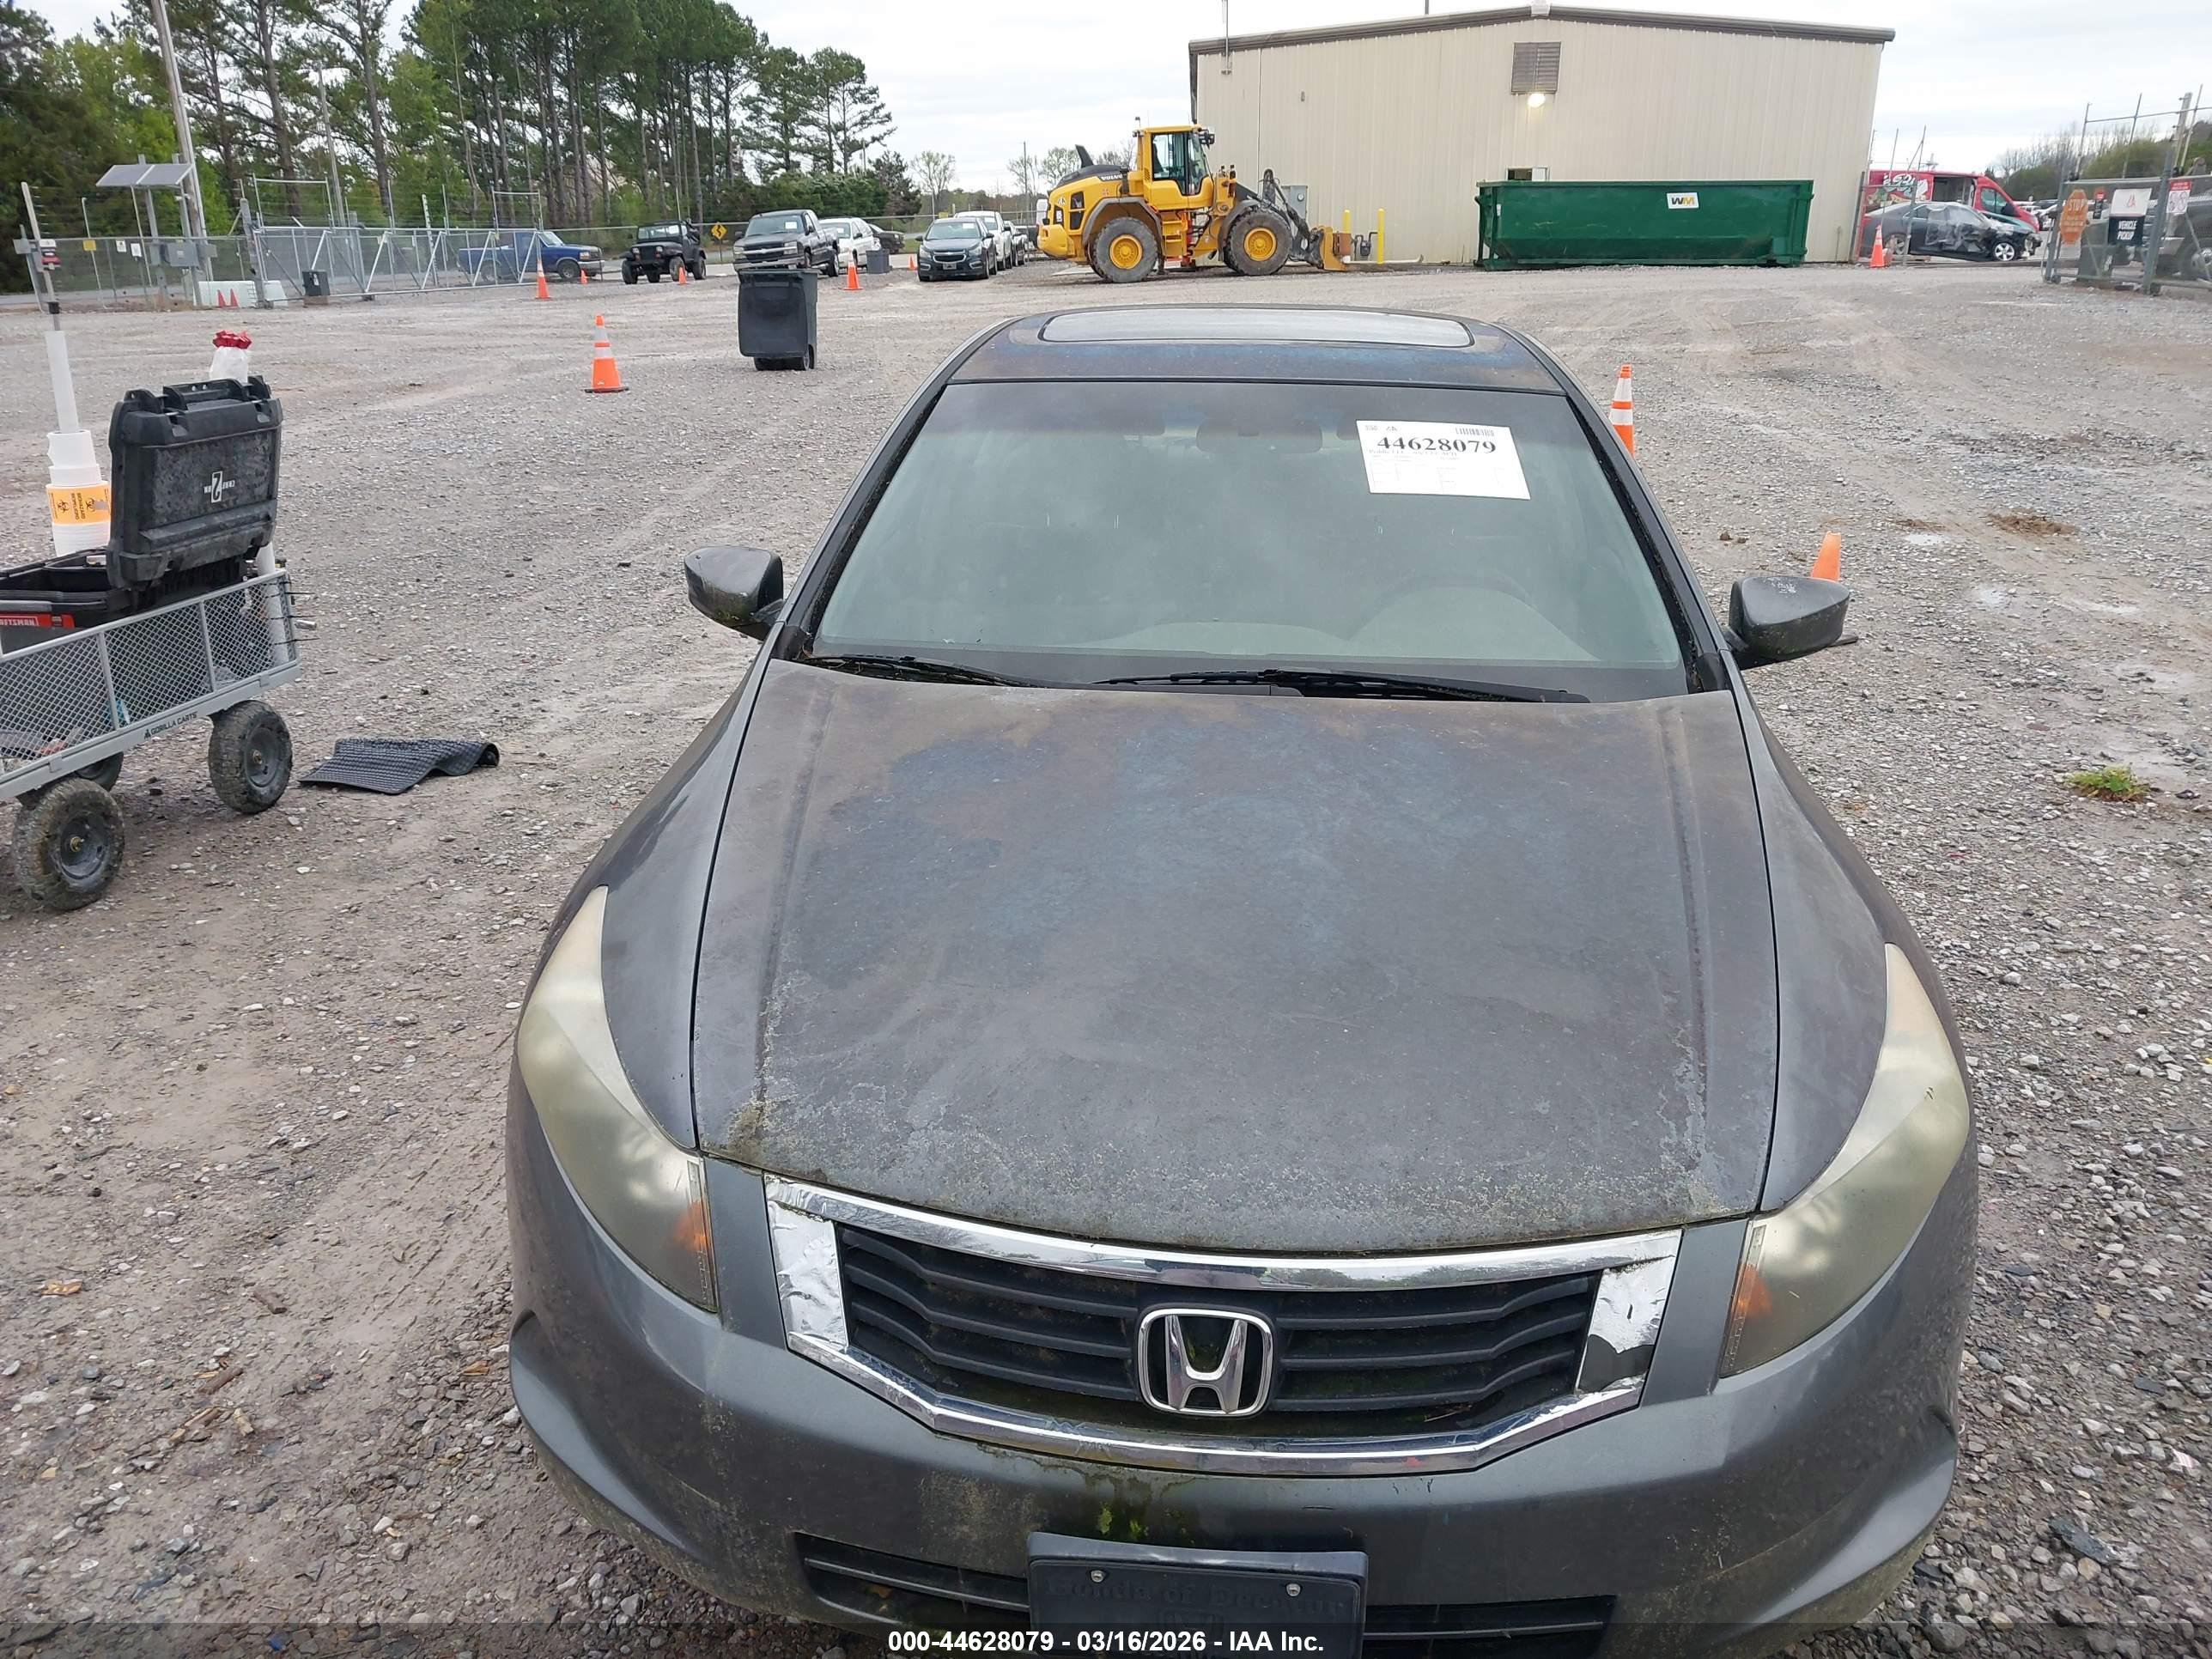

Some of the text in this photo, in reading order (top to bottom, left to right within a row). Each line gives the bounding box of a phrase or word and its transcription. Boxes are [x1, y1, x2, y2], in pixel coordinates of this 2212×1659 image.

[1671, 197, 1695, 205] WM
[2069, 198, 2087, 211] STOP
[2118, 220, 2138, 230] VEHICLE
[2117, 230, 2135, 240] PICKUP
[1376, 436, 1497, 454] 44628079
[150, 712, 198, 736] GORILLA CARTS
